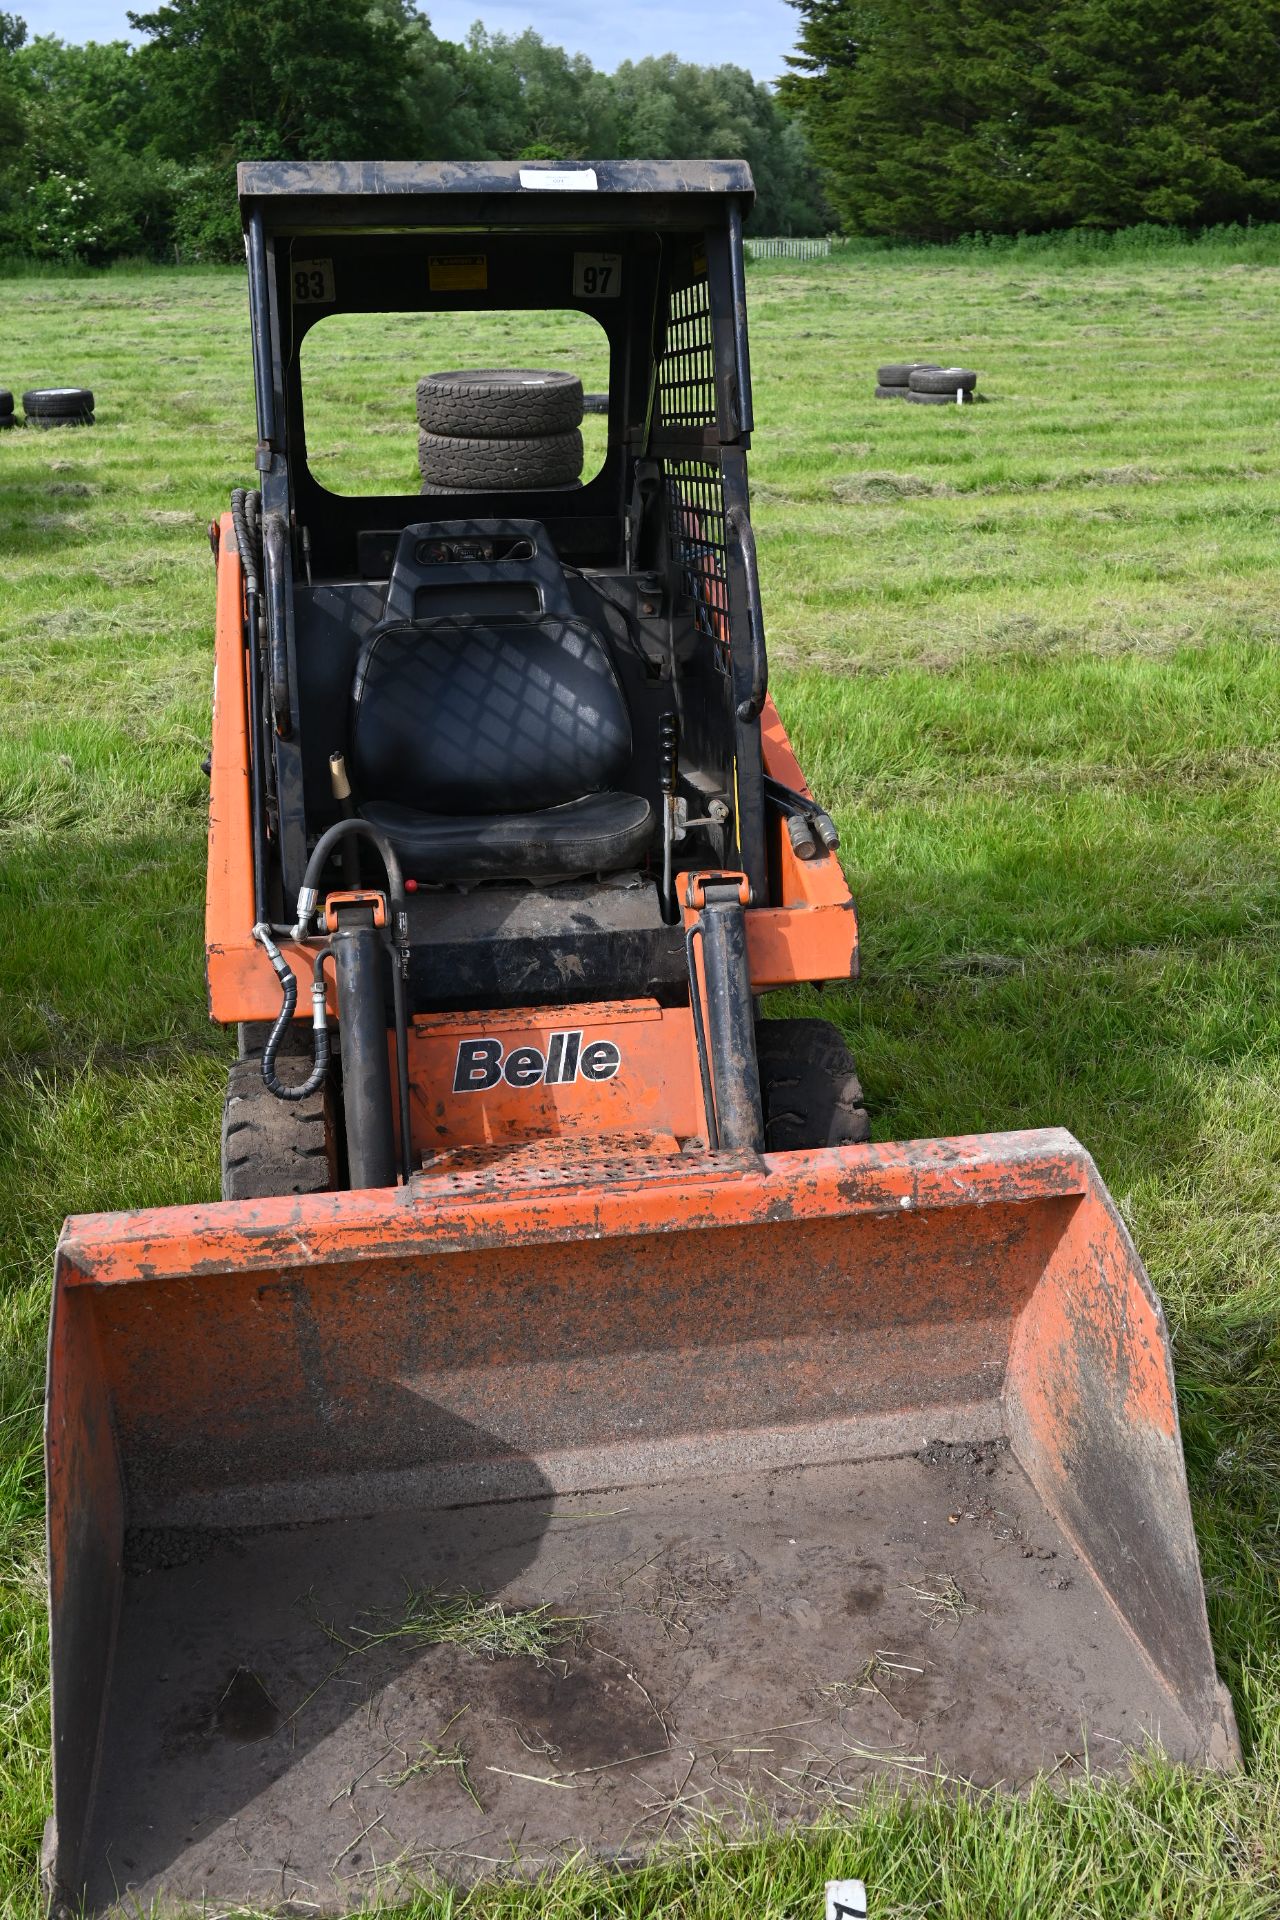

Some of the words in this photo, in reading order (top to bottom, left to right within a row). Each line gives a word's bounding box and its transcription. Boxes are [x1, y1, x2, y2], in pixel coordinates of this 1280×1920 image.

[295, 271, 324, 299] 83
[584, 267, 612, 294] 97
[452, 1030, 621, 1094] Belle
